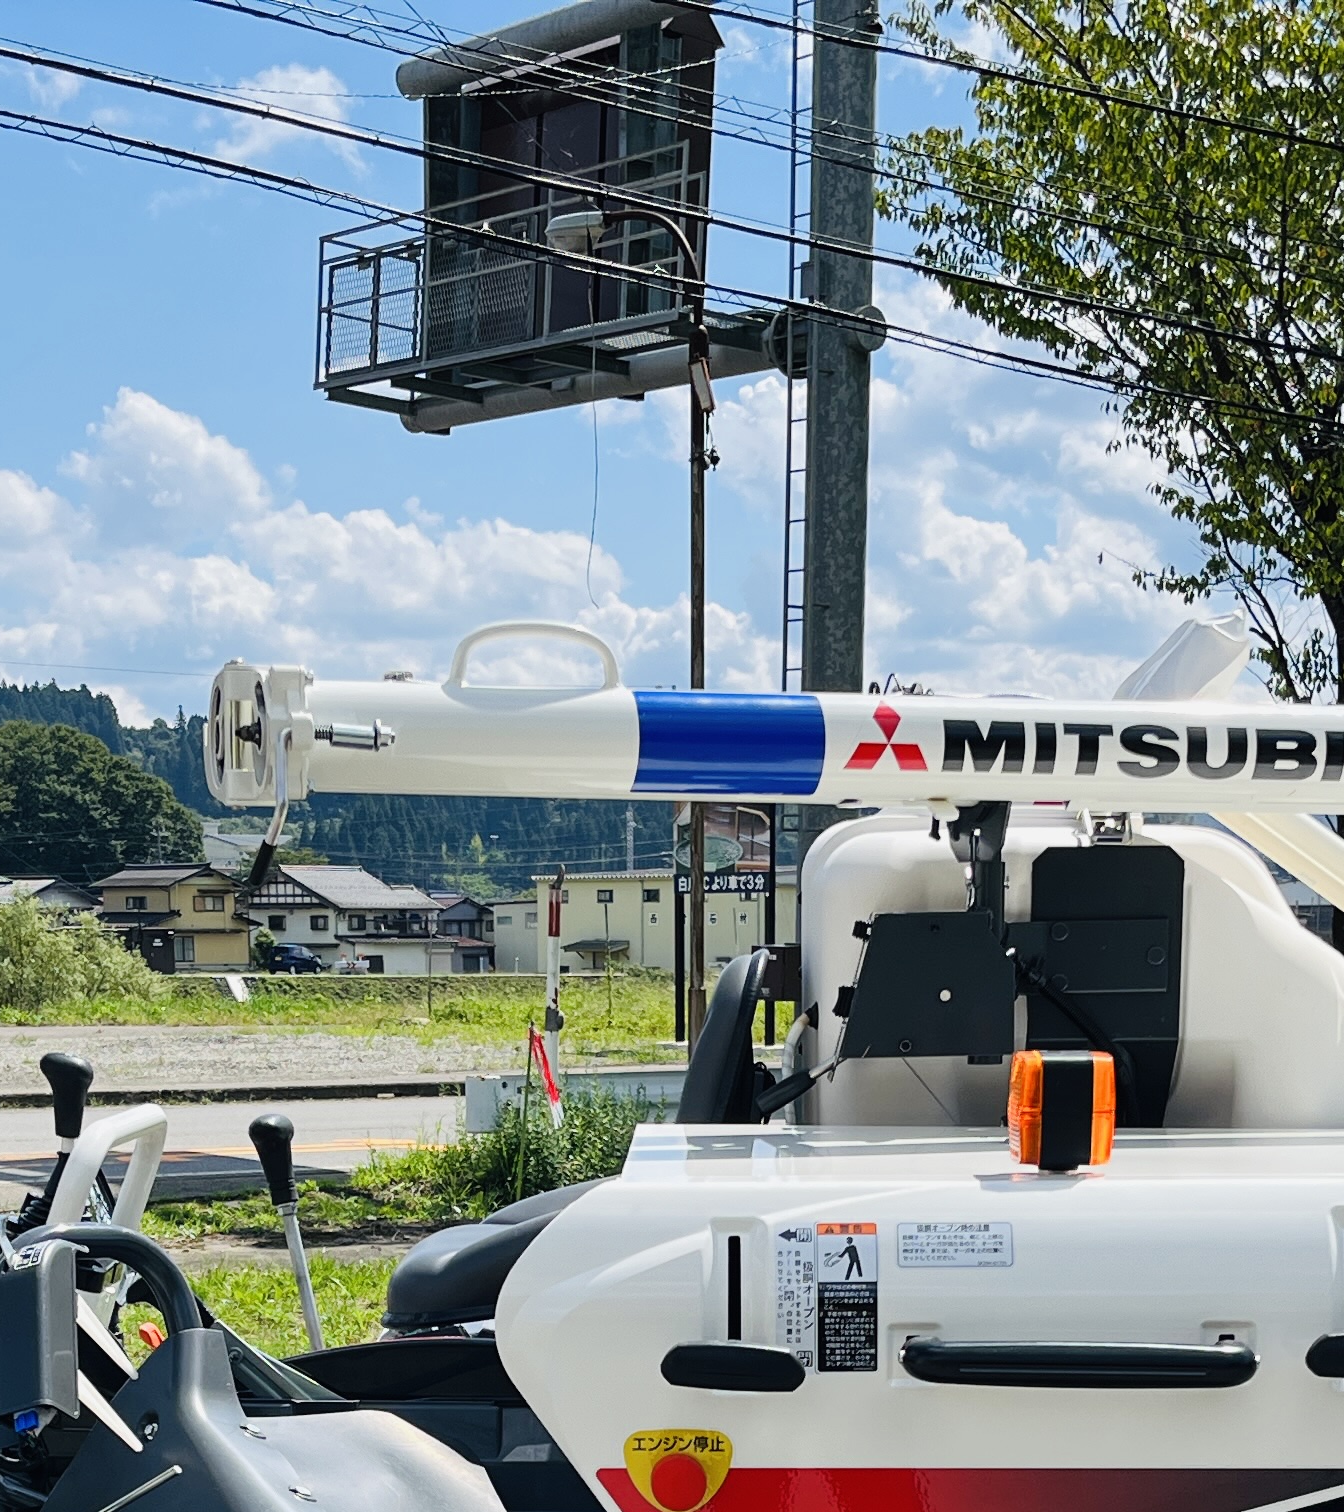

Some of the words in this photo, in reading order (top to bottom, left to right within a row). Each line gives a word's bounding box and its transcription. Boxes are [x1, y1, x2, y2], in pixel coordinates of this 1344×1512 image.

[678, 874, 764, 892] 白Cより車で3分
[632, 1435, 725, 1453] エンジン停止
